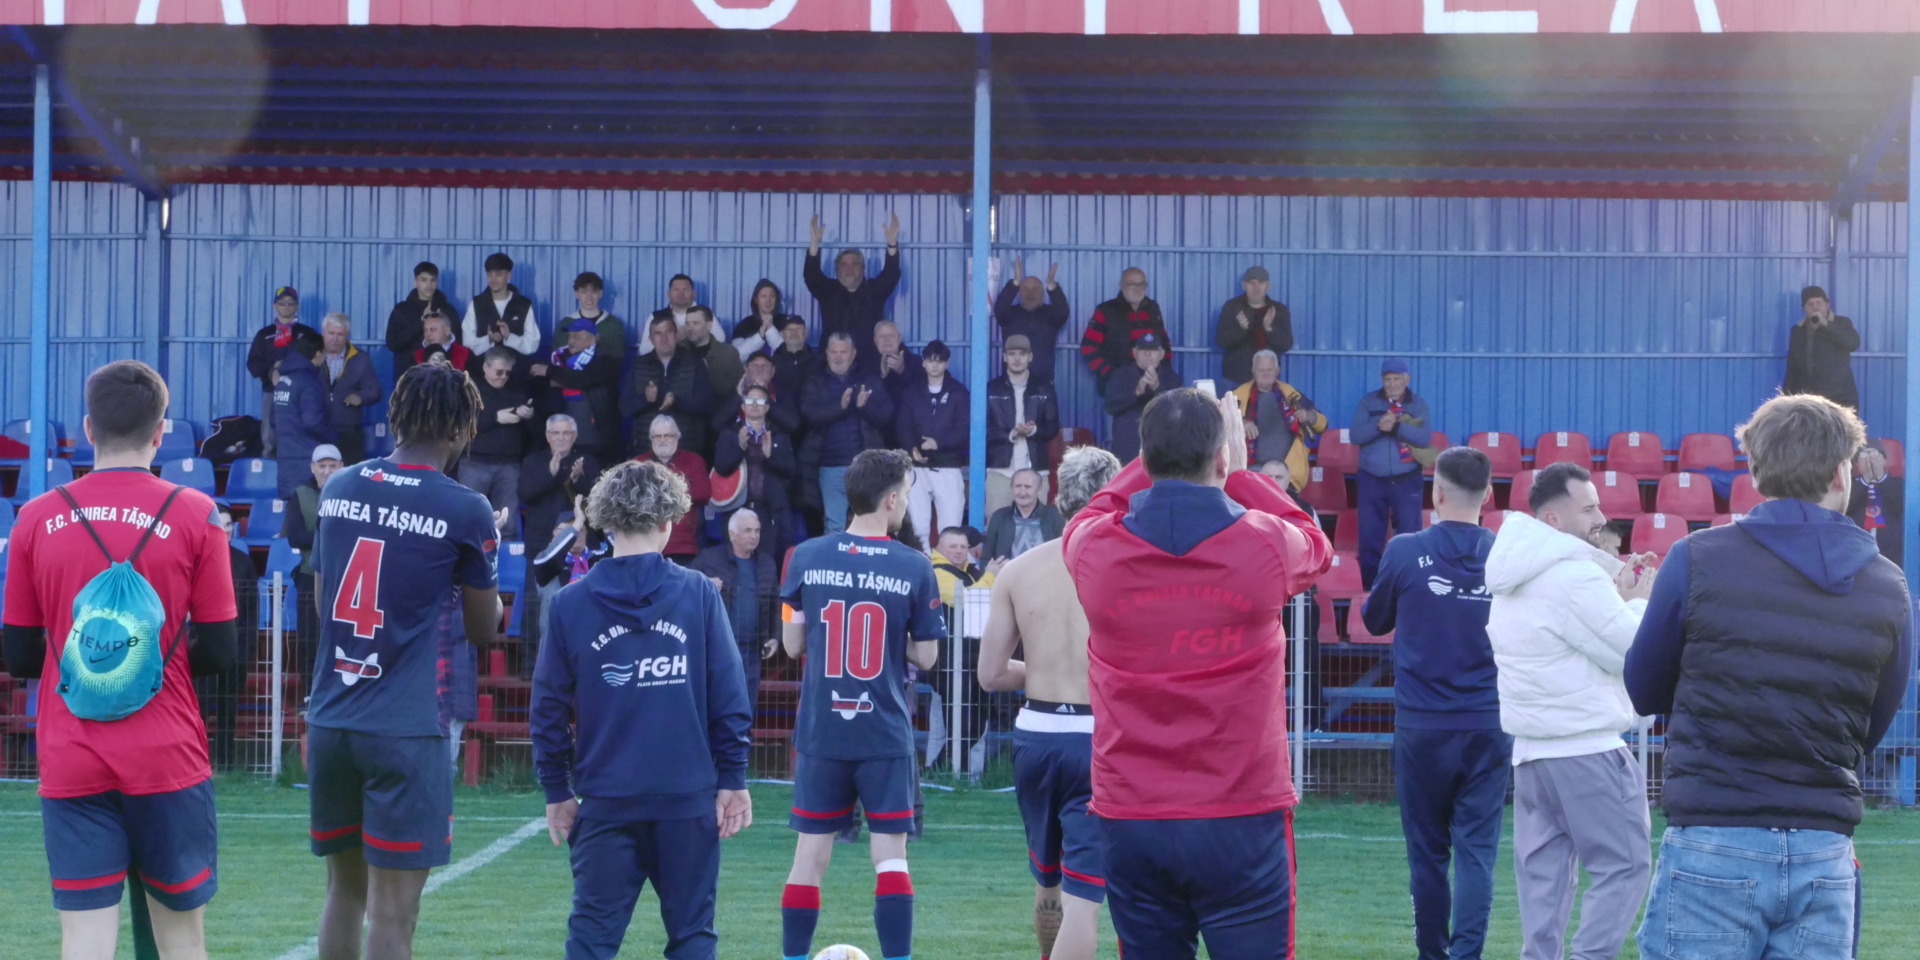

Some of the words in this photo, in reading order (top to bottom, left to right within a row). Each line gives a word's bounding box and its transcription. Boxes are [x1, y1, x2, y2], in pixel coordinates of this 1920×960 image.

[360, 467, 421, 486] transgex
[46, 514, 68, 534] F.C.
[378, 506, 447, 539] TĂȘNAD
[838, 541, 888, 556] transgex
[332, 536, 385, 640] 4
[804, 569, 853, 588] UNIREA
[857, 571, 911, 596] TĂȘNAD
[72, 628, 140, 652] TIEMPO
[590, 633, 611, 651] F.C.
[820, 599, 887, 681] 10
[1170, 626, 1246, 656] FGH
[638, 655, 687, 679] FGH
